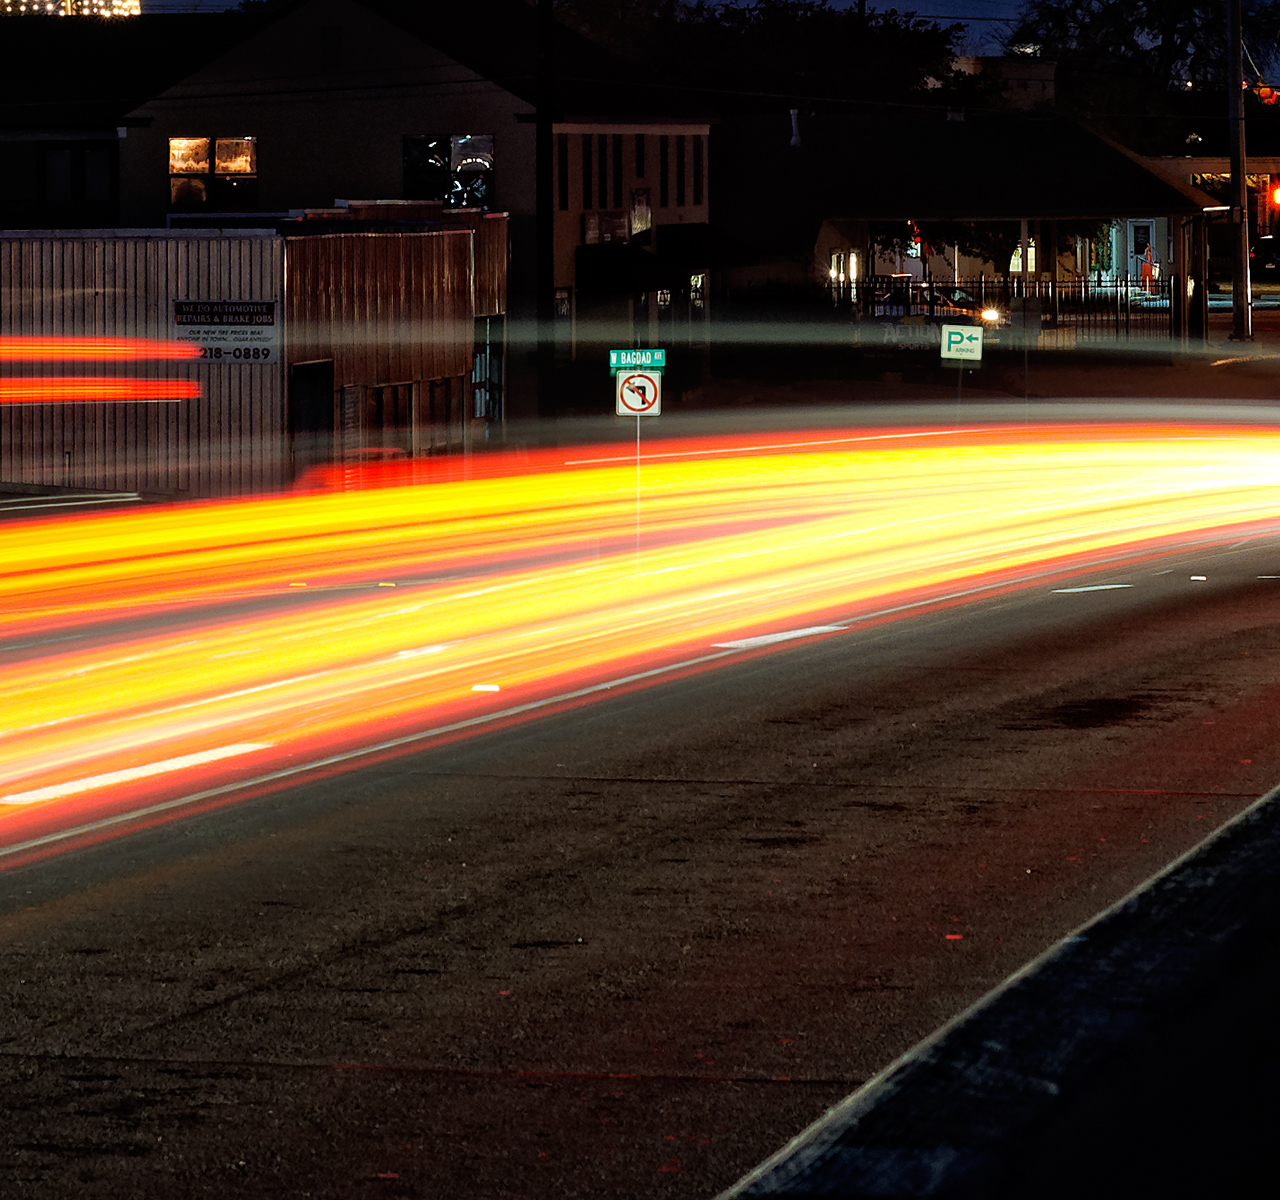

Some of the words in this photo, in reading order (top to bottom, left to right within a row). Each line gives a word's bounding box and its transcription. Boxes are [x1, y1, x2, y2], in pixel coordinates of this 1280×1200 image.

[182, 304, 194, 313] WE
[197, 304, 210, 313] DO
[213, 304, 268, 313] AUTOMOTIVE
[177, 314, 211, 323] REPAIRS
[213, 314, 220, 323] &
[222, 314, 250, 323] BRAKE
[252, 314, 273, 324] JOBS
[199, 347, 271, 360] 218-0889
[610, 352, 617, 365] W
[620, 351, 652, 365] BAGDAD
[654, 351, 663, 360] AVE
